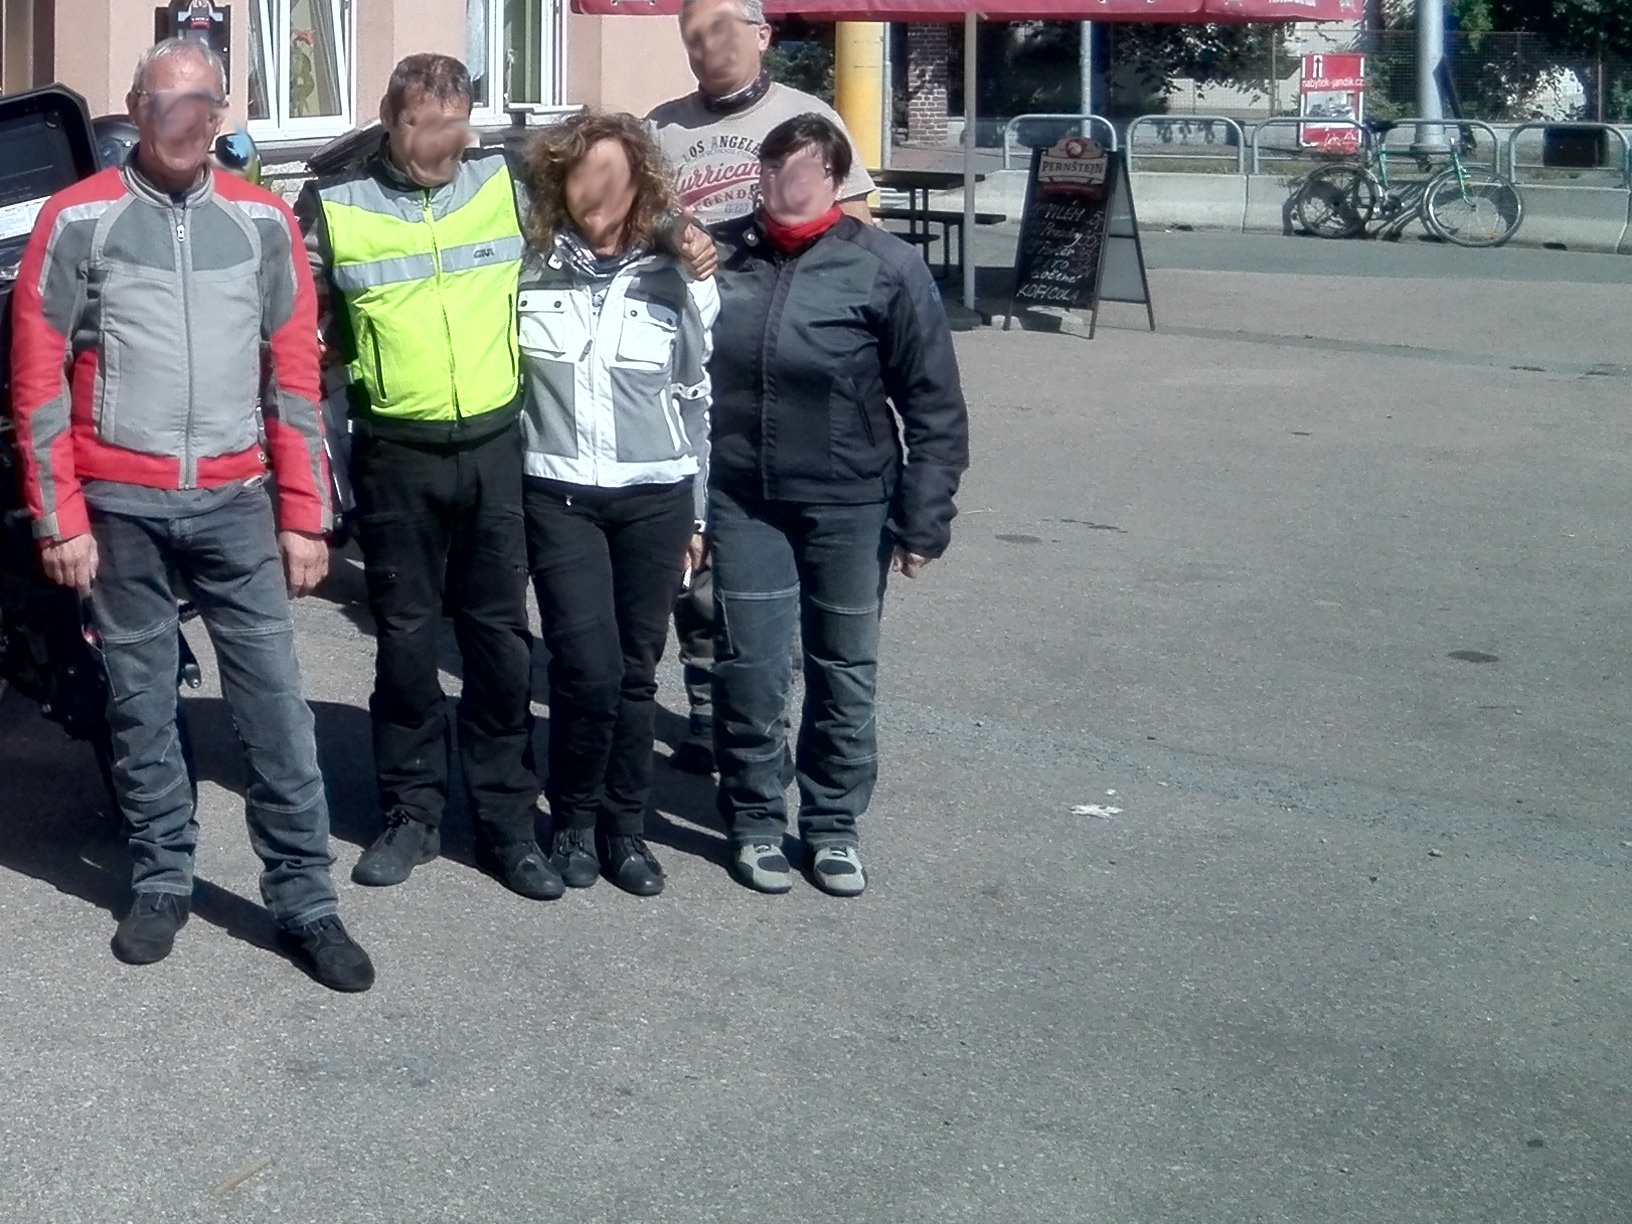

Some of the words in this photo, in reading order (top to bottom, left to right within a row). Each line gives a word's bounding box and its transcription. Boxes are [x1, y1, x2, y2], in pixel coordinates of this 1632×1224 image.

[682, 140, 706, 163] LOS
[710, 134, 762, 158] ANGELE
[675, 160, 761, 195] urrican
[1042, 160, 1104, 174] PERNŠTEJN
[692, 189, 760, 213] EGENDS
